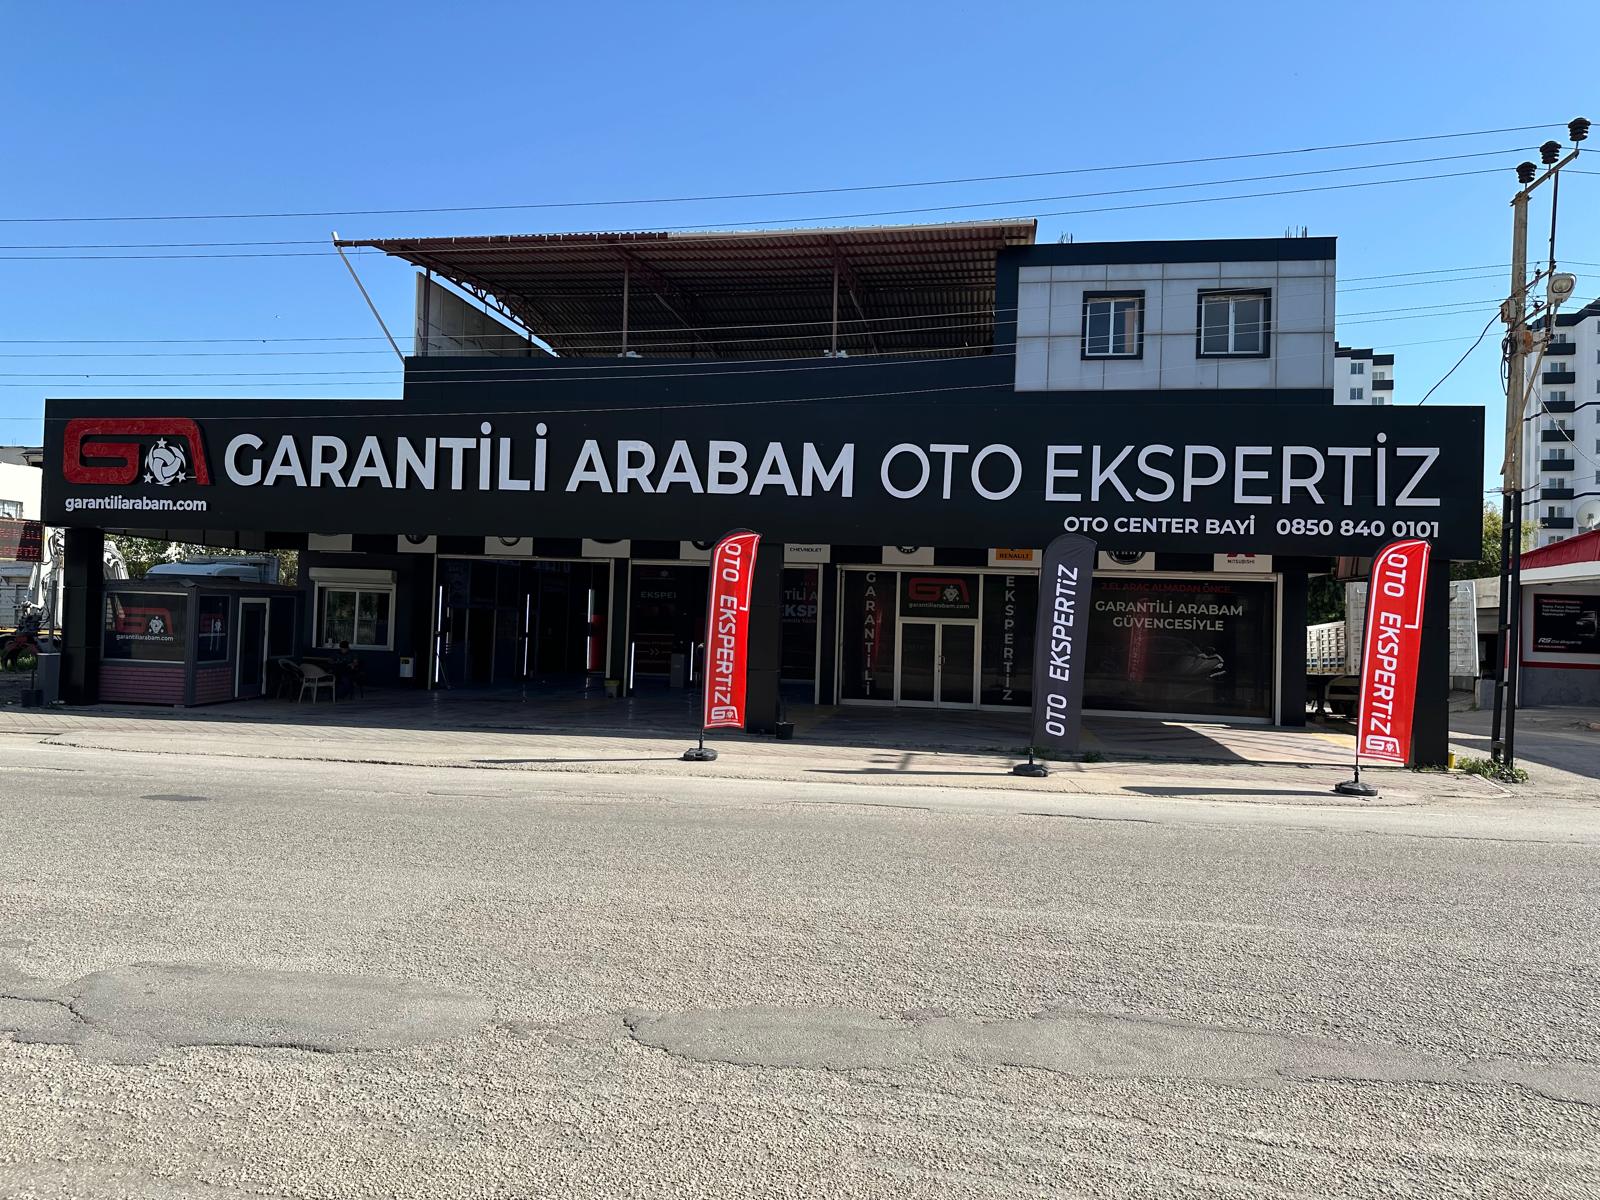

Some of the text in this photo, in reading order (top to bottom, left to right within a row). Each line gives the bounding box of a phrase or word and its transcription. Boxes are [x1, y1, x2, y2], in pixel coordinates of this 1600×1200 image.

[224, 421, 1441, 507] GARANTİLİ ARABAM OTO EKSPERTİZ
[65, 495, 207, 512] garantiliarabam.com
[1063, 514, 1439, 538] OTO CENTER BAYİ 0850 840 0101
[722, 543, 742, 583] OTO
[999, 552, 1030, 560] RENAULT
[1383, 553, 1408, 598] OTO
[1095, 599, 1243, 617] GARANTİLİ ARABAM
[1112, 614, 1225, 631] GÜVENCESİYLE
[1045, 693, 1067, 737] OTO
